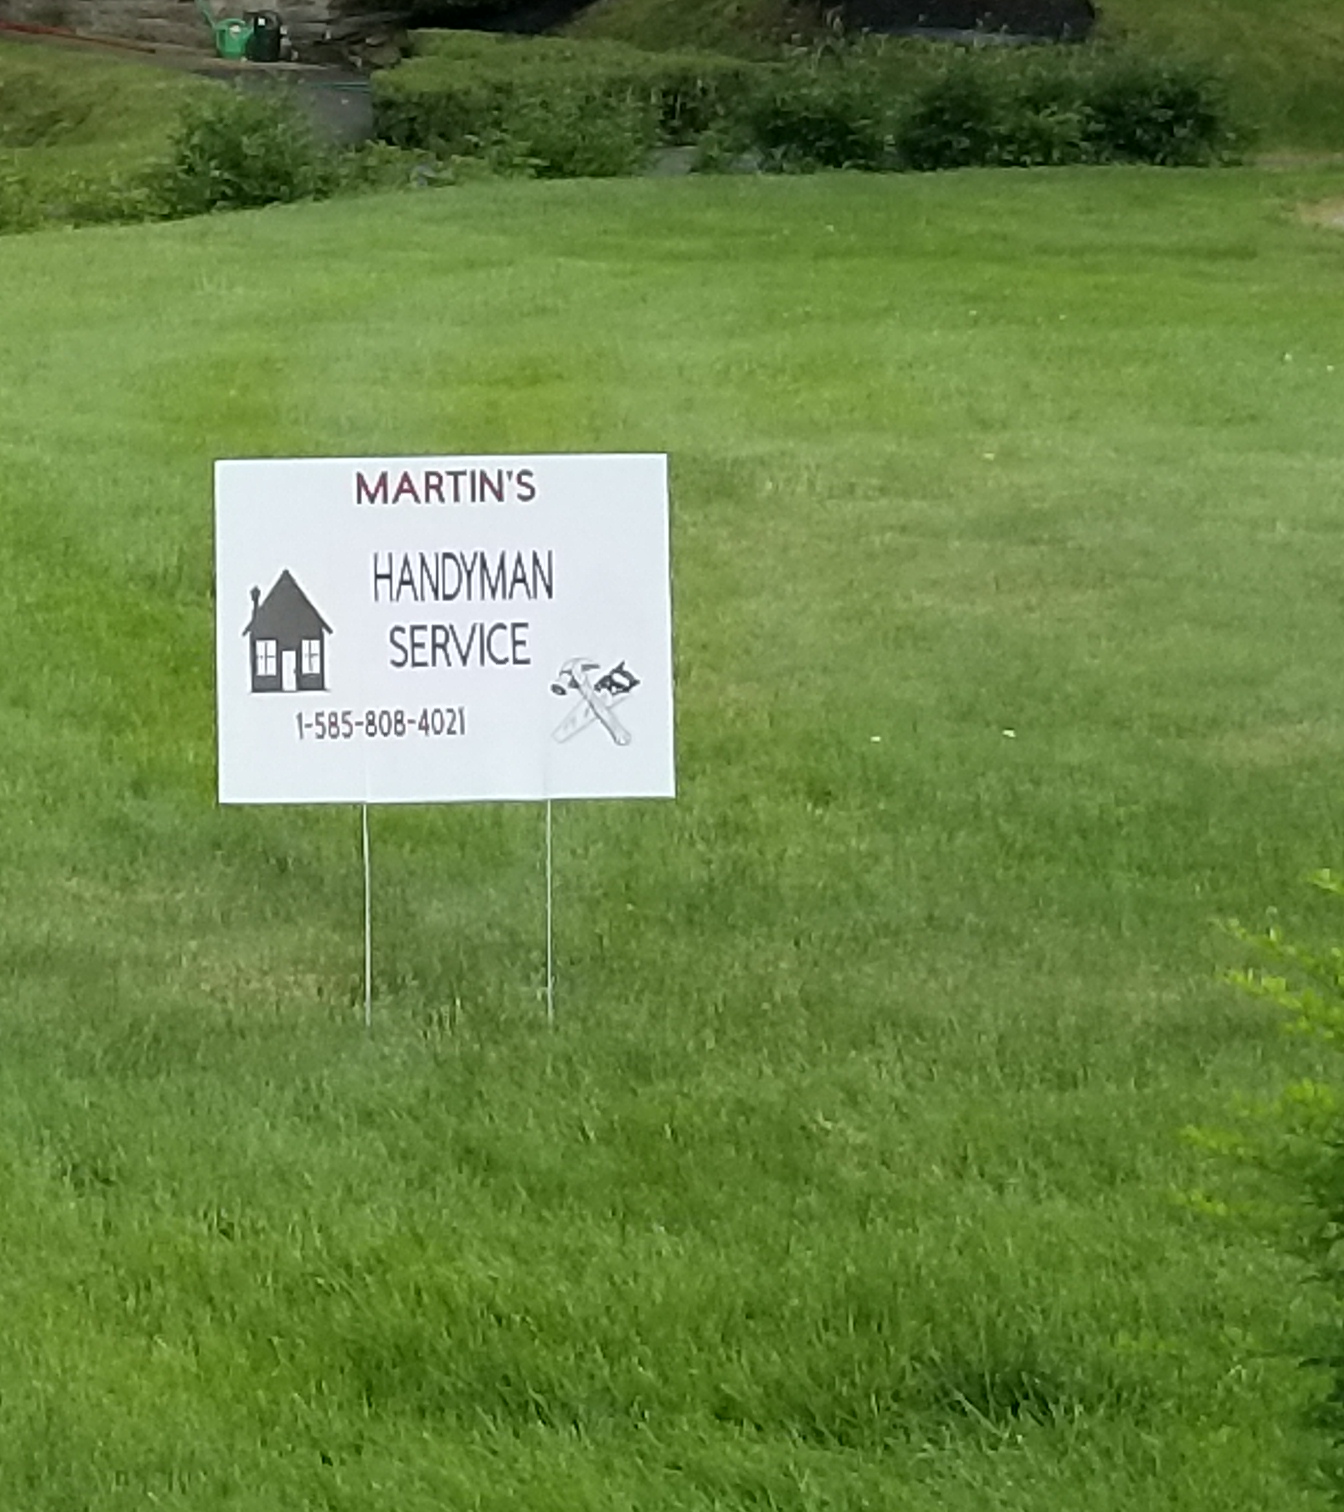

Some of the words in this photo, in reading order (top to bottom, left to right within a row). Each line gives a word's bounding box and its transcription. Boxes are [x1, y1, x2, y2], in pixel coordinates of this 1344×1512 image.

[355, 467, 537, 506] MARTIN'S
[372, 549, 554, 603] HANDYMAN
[388, 621, 532, 669] SERVICE
[295, 706, 467, 741] 1-585-808-4021
